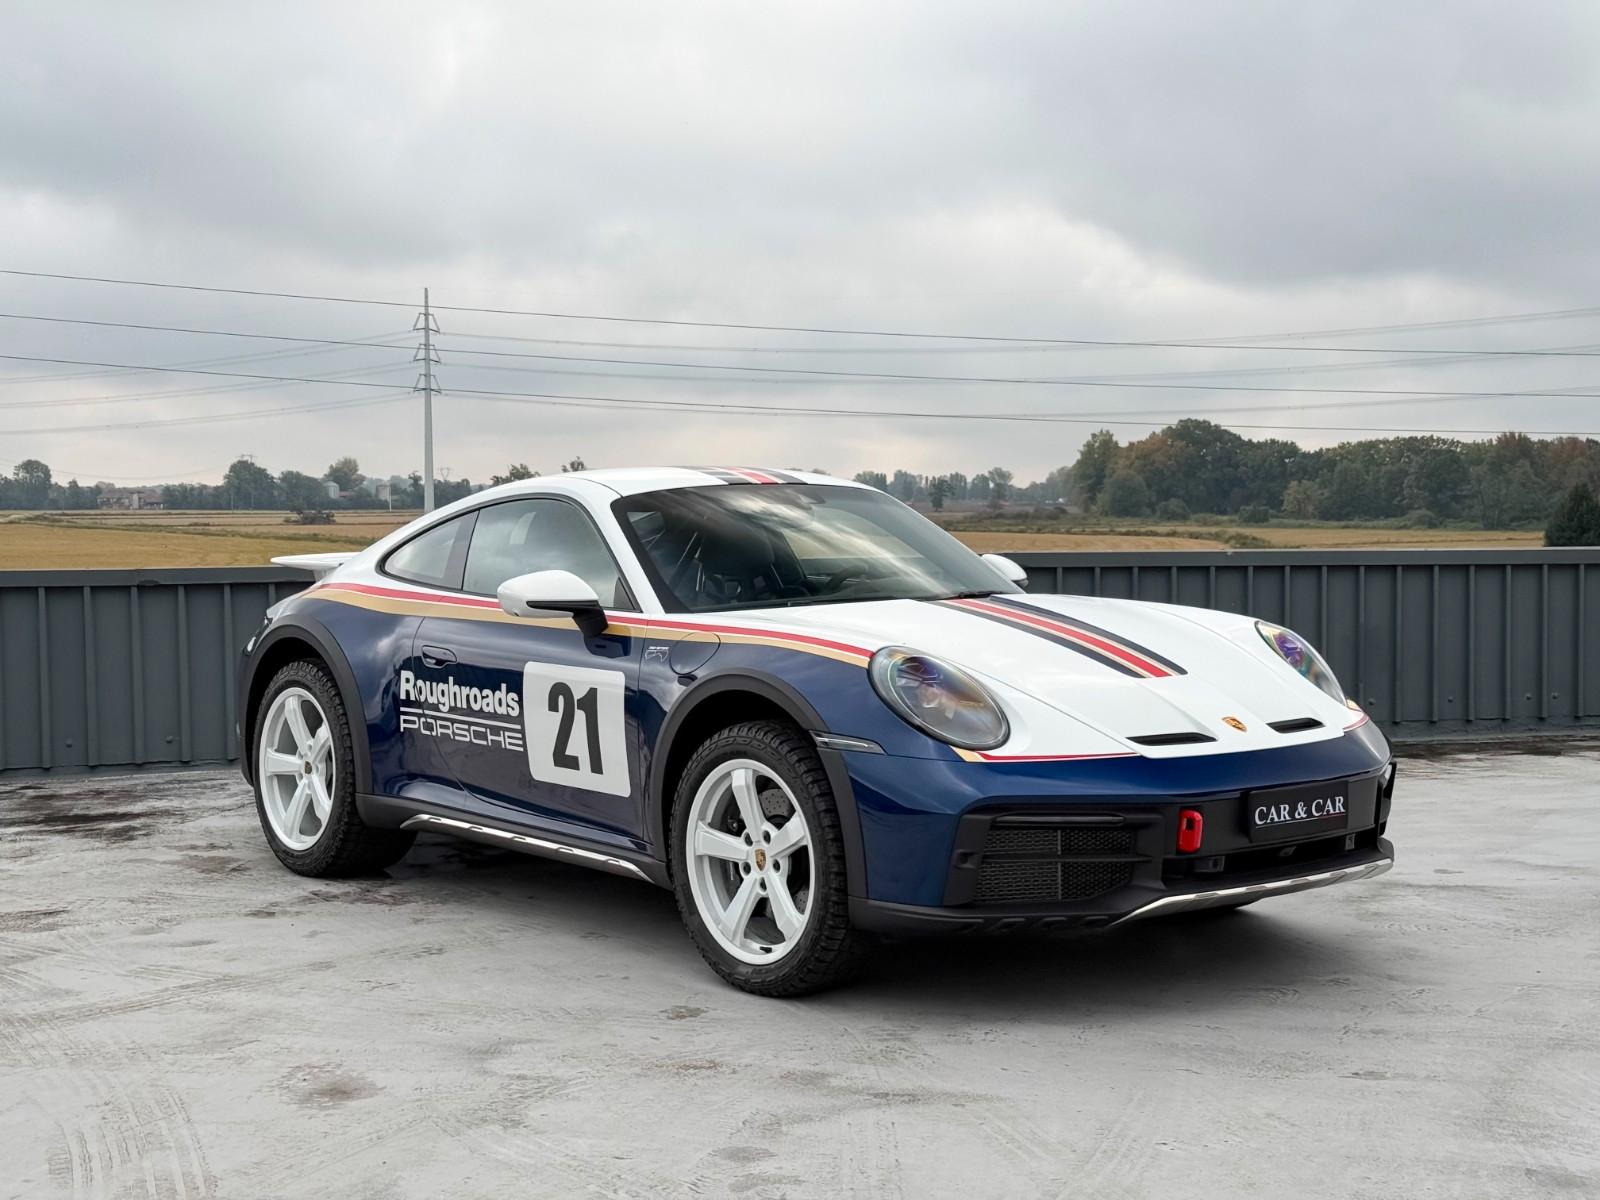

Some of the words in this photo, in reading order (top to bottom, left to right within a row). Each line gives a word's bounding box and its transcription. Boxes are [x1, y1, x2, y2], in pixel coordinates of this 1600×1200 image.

[400, 670, 520, 717] Roughroads
[400, 715, 524, 752] PORSCHE
[548, 682, 604, 775] 21
[1254, 804, 1290, 825] CAR
[1294, 801, 1307, 819] &
[1311, 796, 1346, 817] CAR
